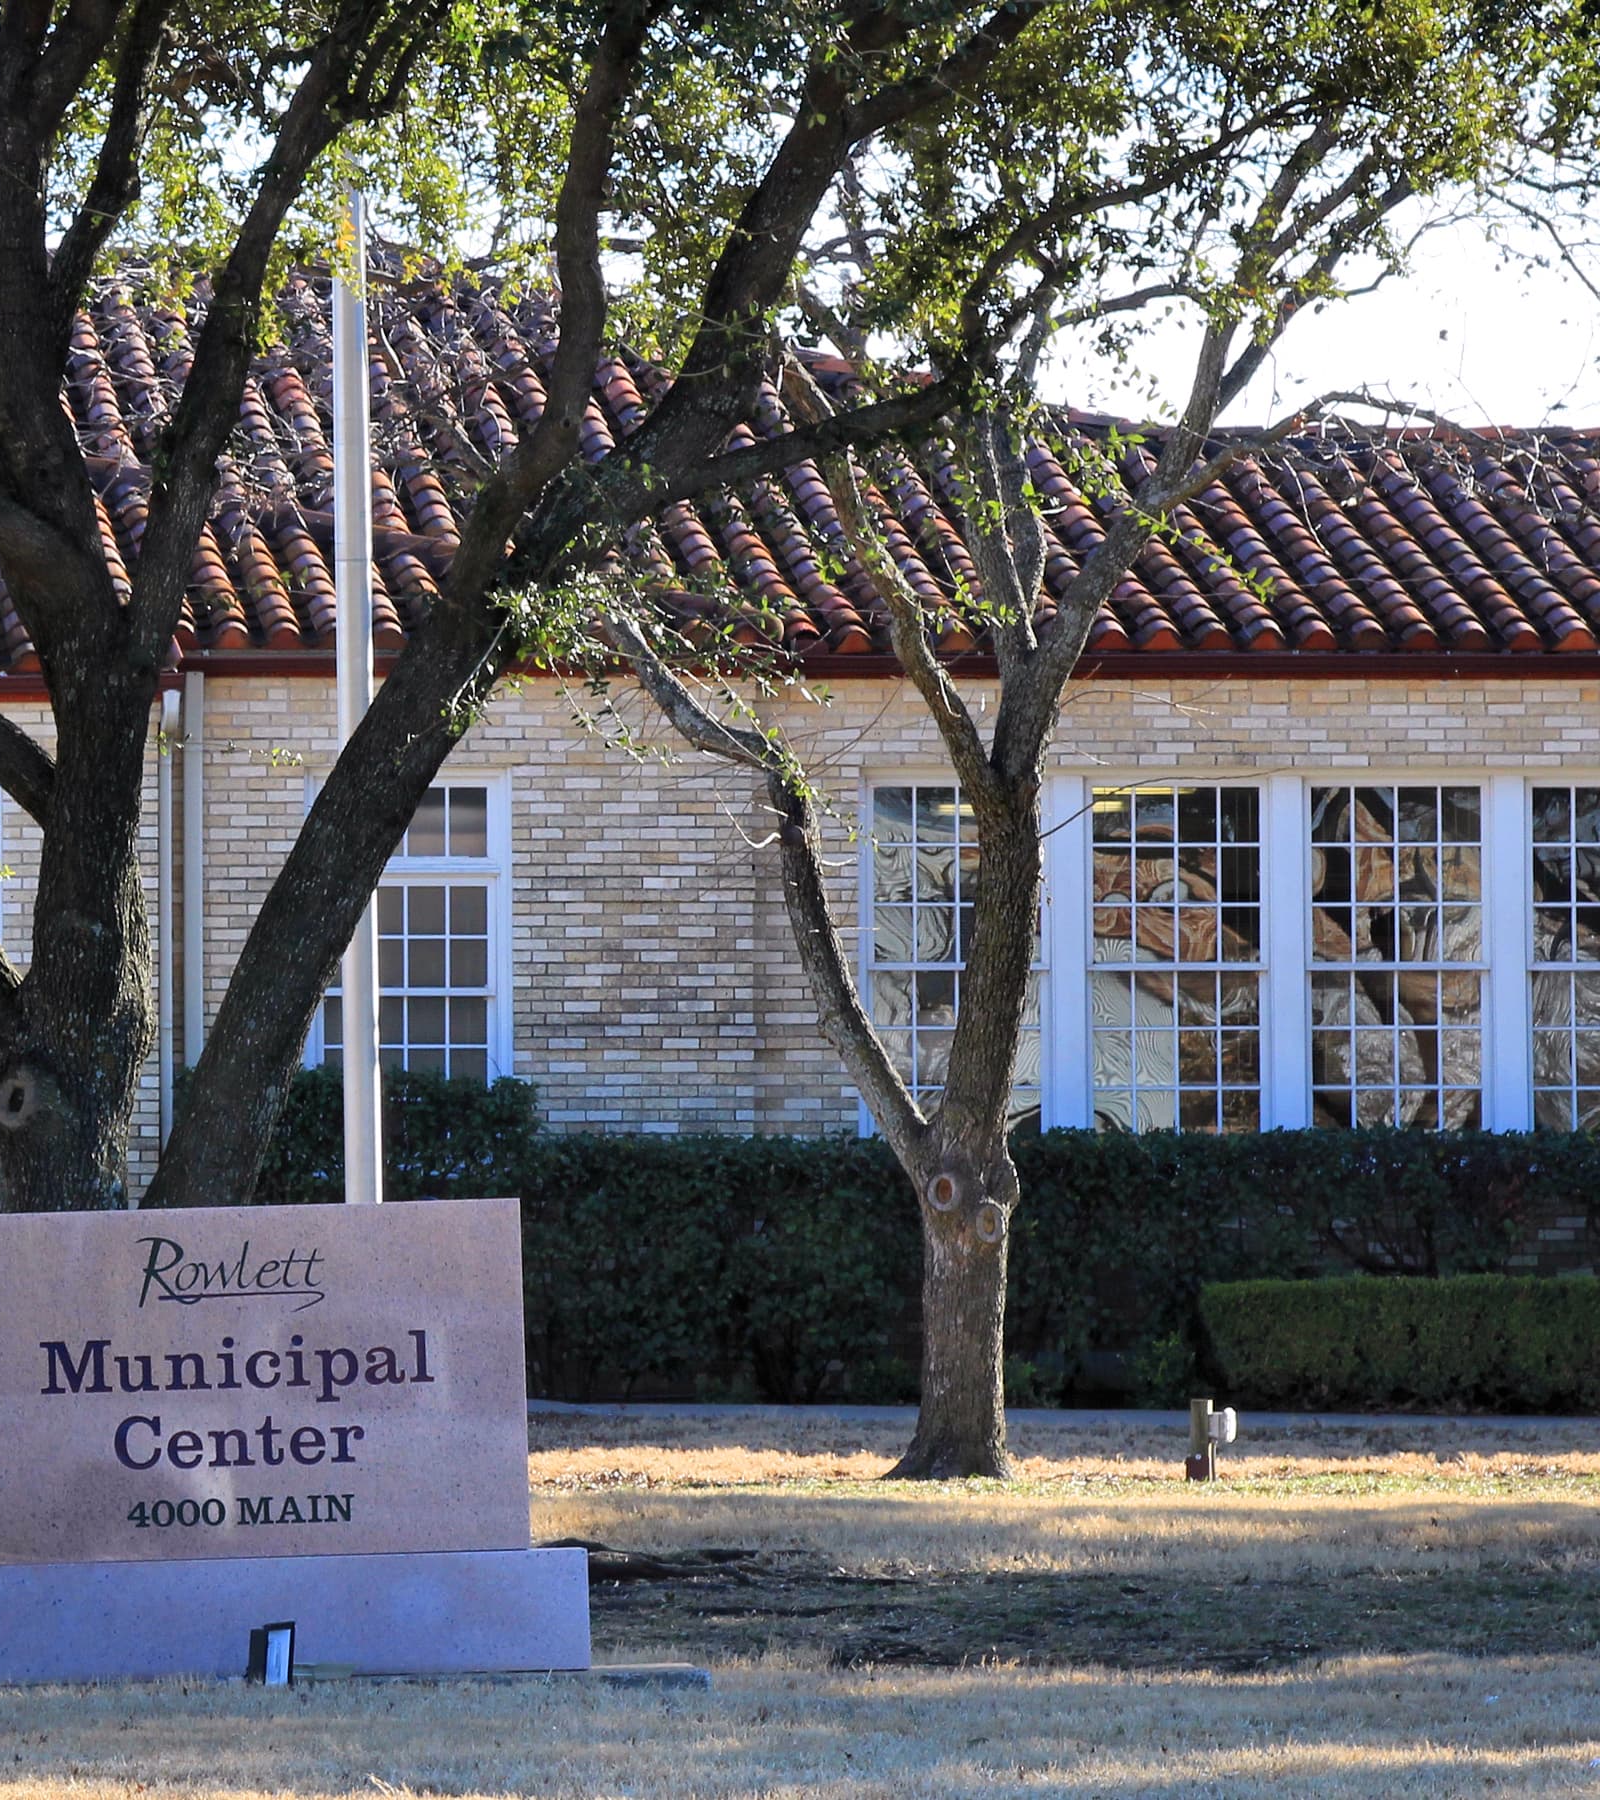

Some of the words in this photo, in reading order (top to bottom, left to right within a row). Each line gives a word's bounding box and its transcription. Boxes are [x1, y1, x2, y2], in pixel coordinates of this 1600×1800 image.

[135, 1237, 325, 1311] Rowlett
[40, 1330, 434, 1402] Municipal
[114, 1416, 365, 1470] Center
[127, 1500, 226, 1527] 4000
[237, 1494, 354, 1525] MAIN
